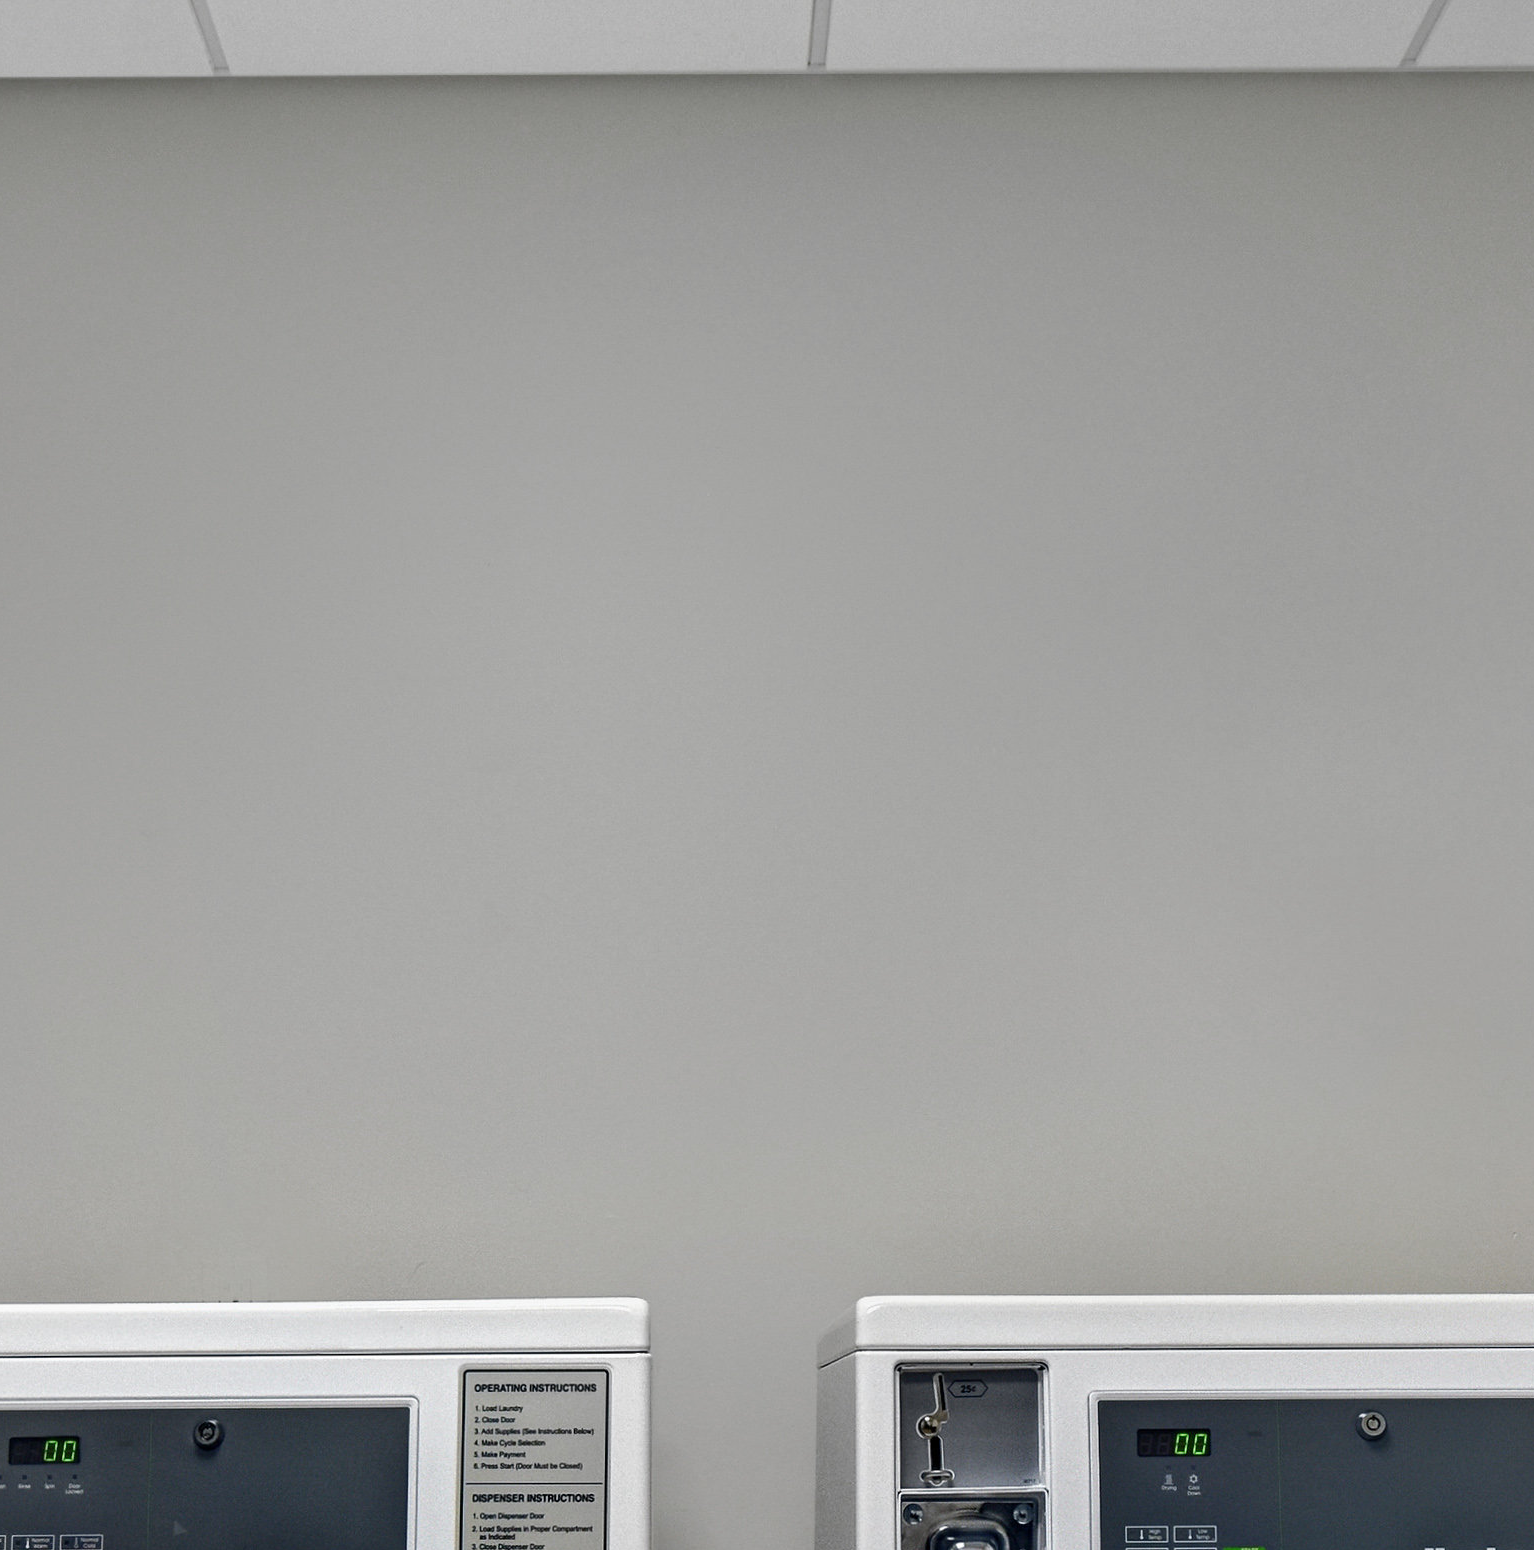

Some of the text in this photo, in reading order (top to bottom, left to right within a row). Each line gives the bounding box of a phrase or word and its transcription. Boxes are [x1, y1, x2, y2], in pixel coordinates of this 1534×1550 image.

[474, 1384, 597, 1392] OPERATING INSTRUCTIONS
[499, 1440, 516, 1448] Cycle
[1175, 1433, 1207, 1455] 00
[44, 1440, 76, 1461] 00
[472, 1494, 595, 1502] DISPENSER INSTRUCTIONS
